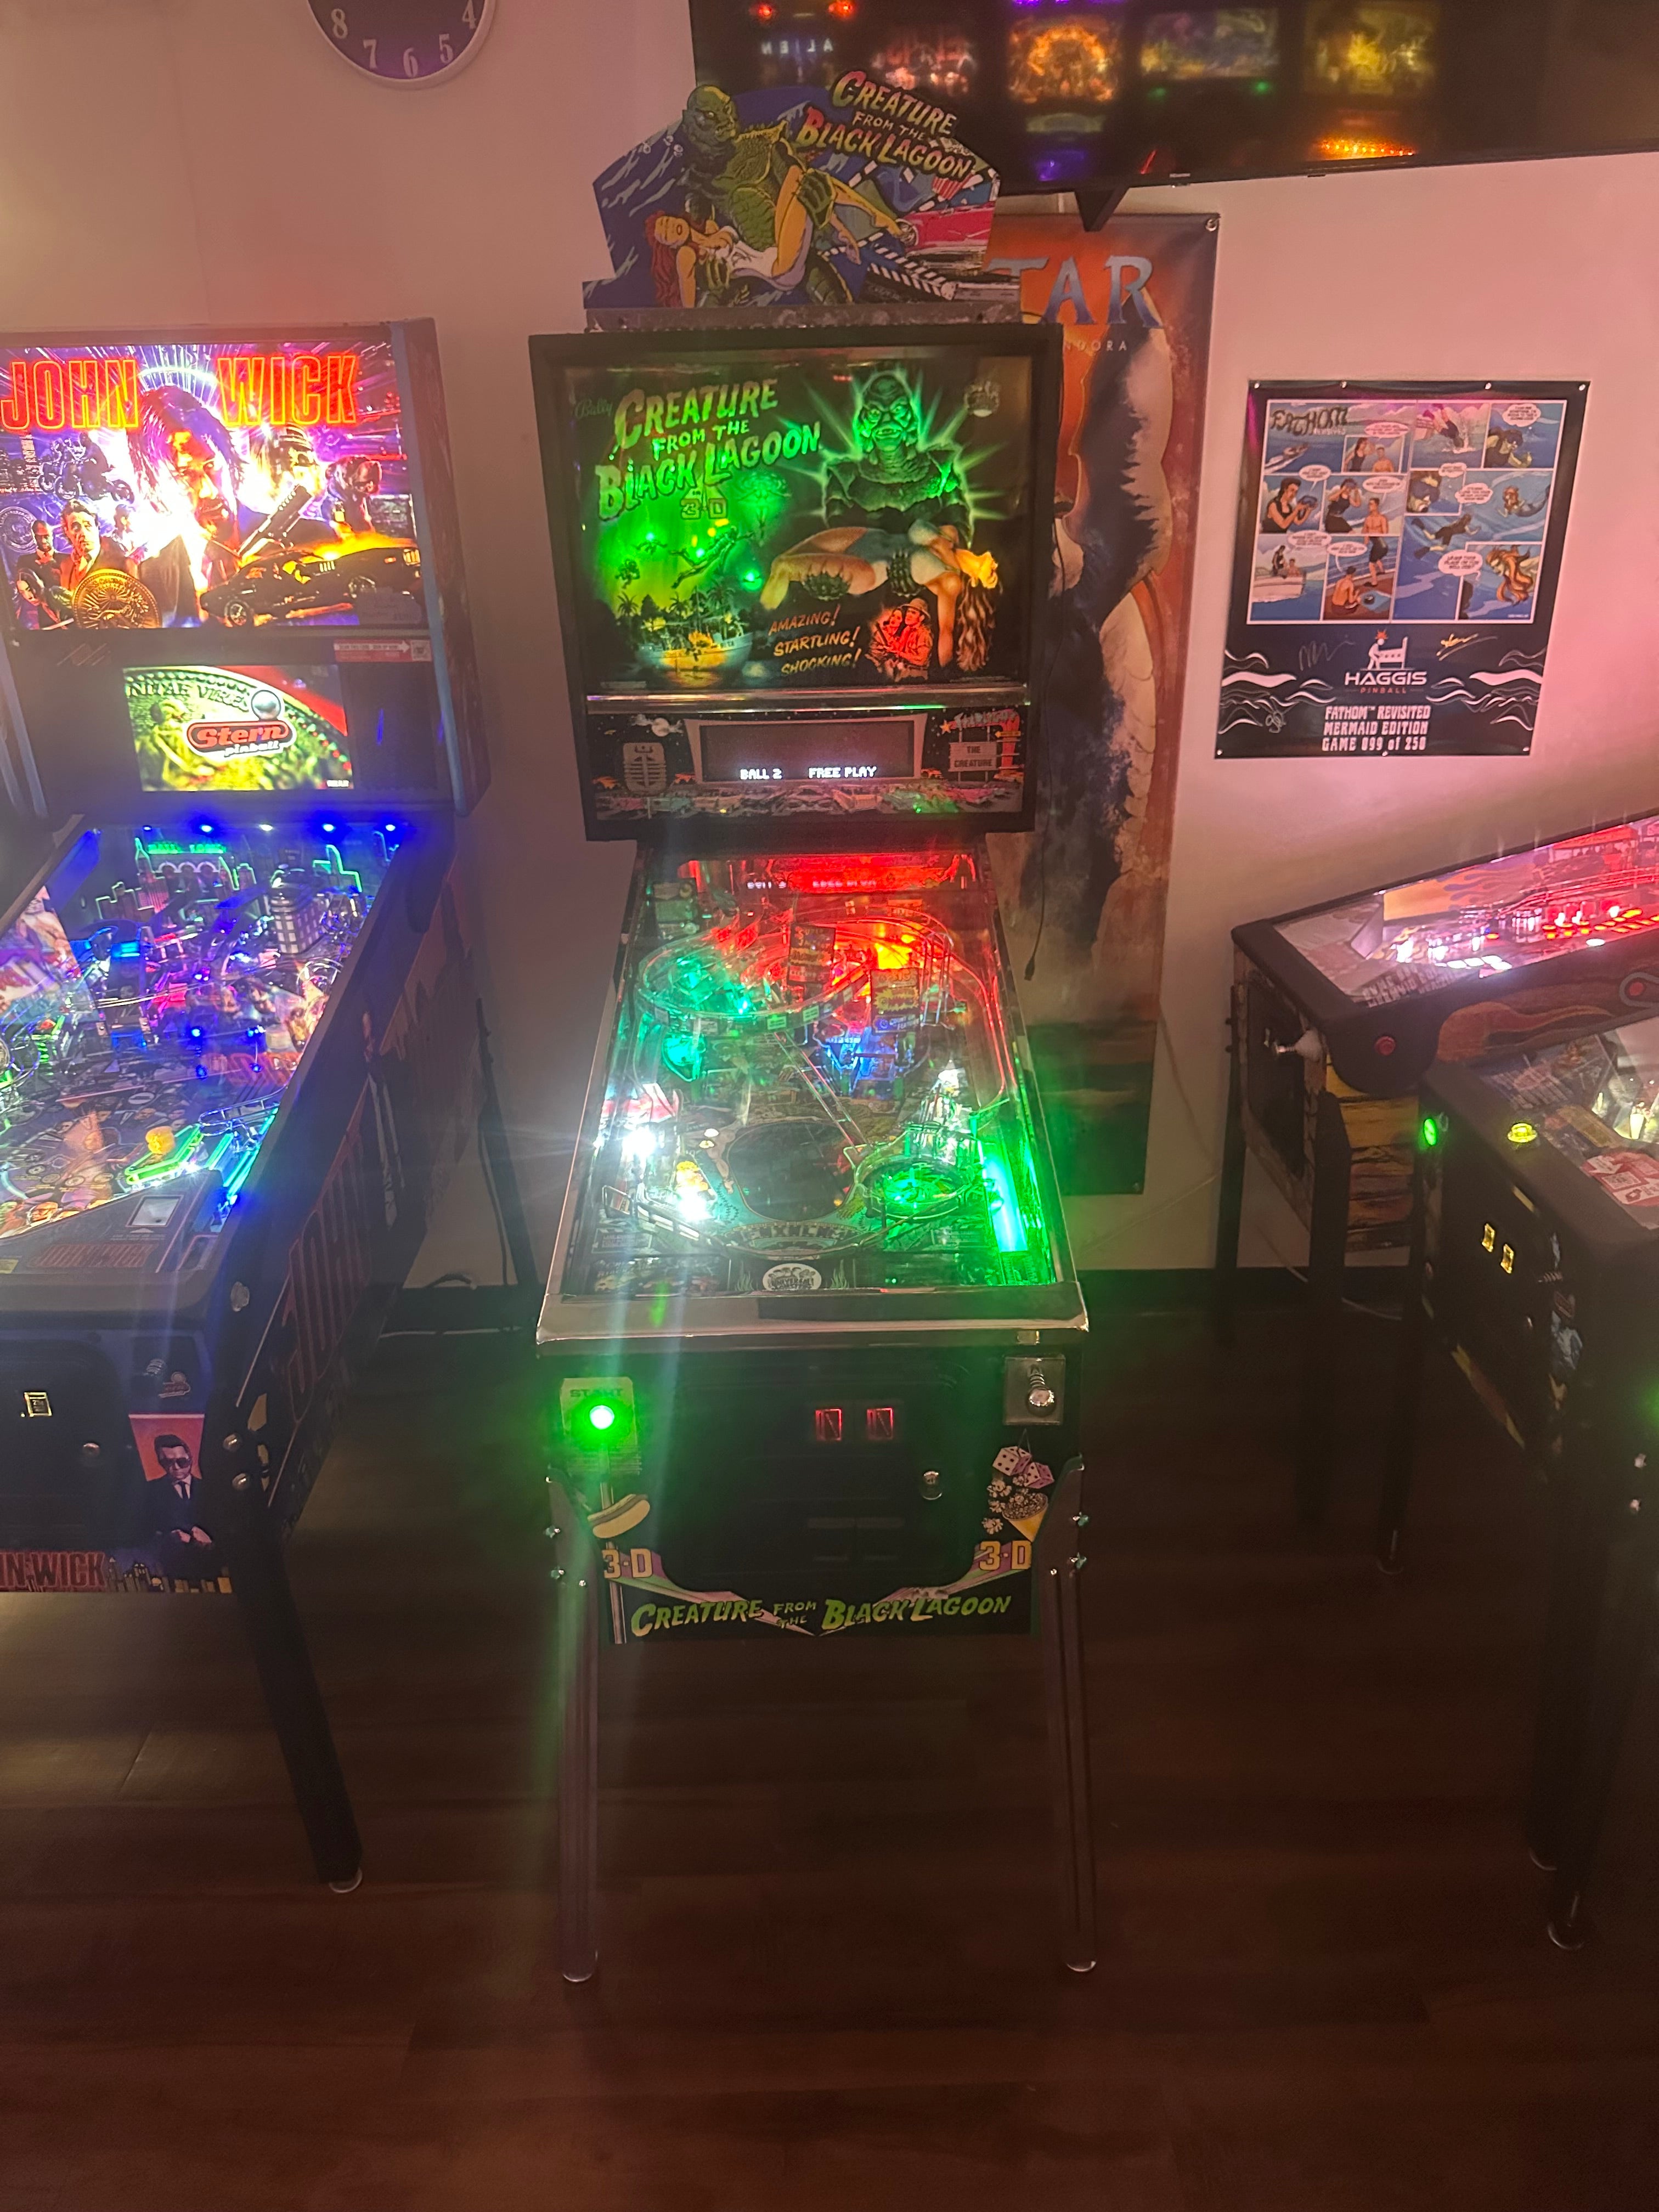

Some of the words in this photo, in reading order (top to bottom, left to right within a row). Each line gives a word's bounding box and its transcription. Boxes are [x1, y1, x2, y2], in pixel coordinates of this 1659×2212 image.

[331, 8, 348, 39] 8
[461, 0, 477, 30] 4
[363, 39, 379, 69] 7
[403, 47, 419, 78] 6
[439, 33, 454, 64] 5
[832, 70, 957, 137] CREATURE
[852, 111, 894, 131] FROM
[899, 125, 924, 141] THE
[795, 106, 881, 158] BLACK
[878, 133, 972, 178] LAGOON
[0, 359, 139, 430] JOHN
[217, 356, 358, 427] WICK
[614, 379, 778, 450] CREATURE
[652, 428, 706, 461] FROM
[712, 419, 750, 441] THE
[595, 449, 697, 521] BLACK
[704, 421, 821, 486] LAGOON
[768, 603, 841, 636] AMAZING!
[773, 625, 861, 657] STARTLING!
[781, 648, 862, 675] SHOCKING!
[1345, 671, 1427, 685] HAGGIS
[1376, 705, 1431, 720] REVISITED
[196, 725, 282, 747] Stern
[1323, 721, 1379, 736] MERMAID
[1381, 720, 1429, 735] EDITION
[224, 741, 279, 758] pinball
[967, 746, 981, 754] THE
[1322, 737, 1357, 751] GAME
[1361, 736, 1384, 751] 099
[1387, 736, 1401, 751] of
[1404, 736, 1427, 751] 250
[740, 768, 770, 780] BALL
[772, 769, 782, 779] 2
[808, 768, 842, 779] FREE
[844, 766, 877, 777] PLAY
[30, 1551, 106, 1588] WICK
[630, 1599, 764, 1637] CREATURE
[772, 1601, 817, 1616] FROM
[776, 1615, 808, 1629] THE
[821, 1598, 911, 1630] BLACK
[910, 1595, 1012, 1622] LAGOON
